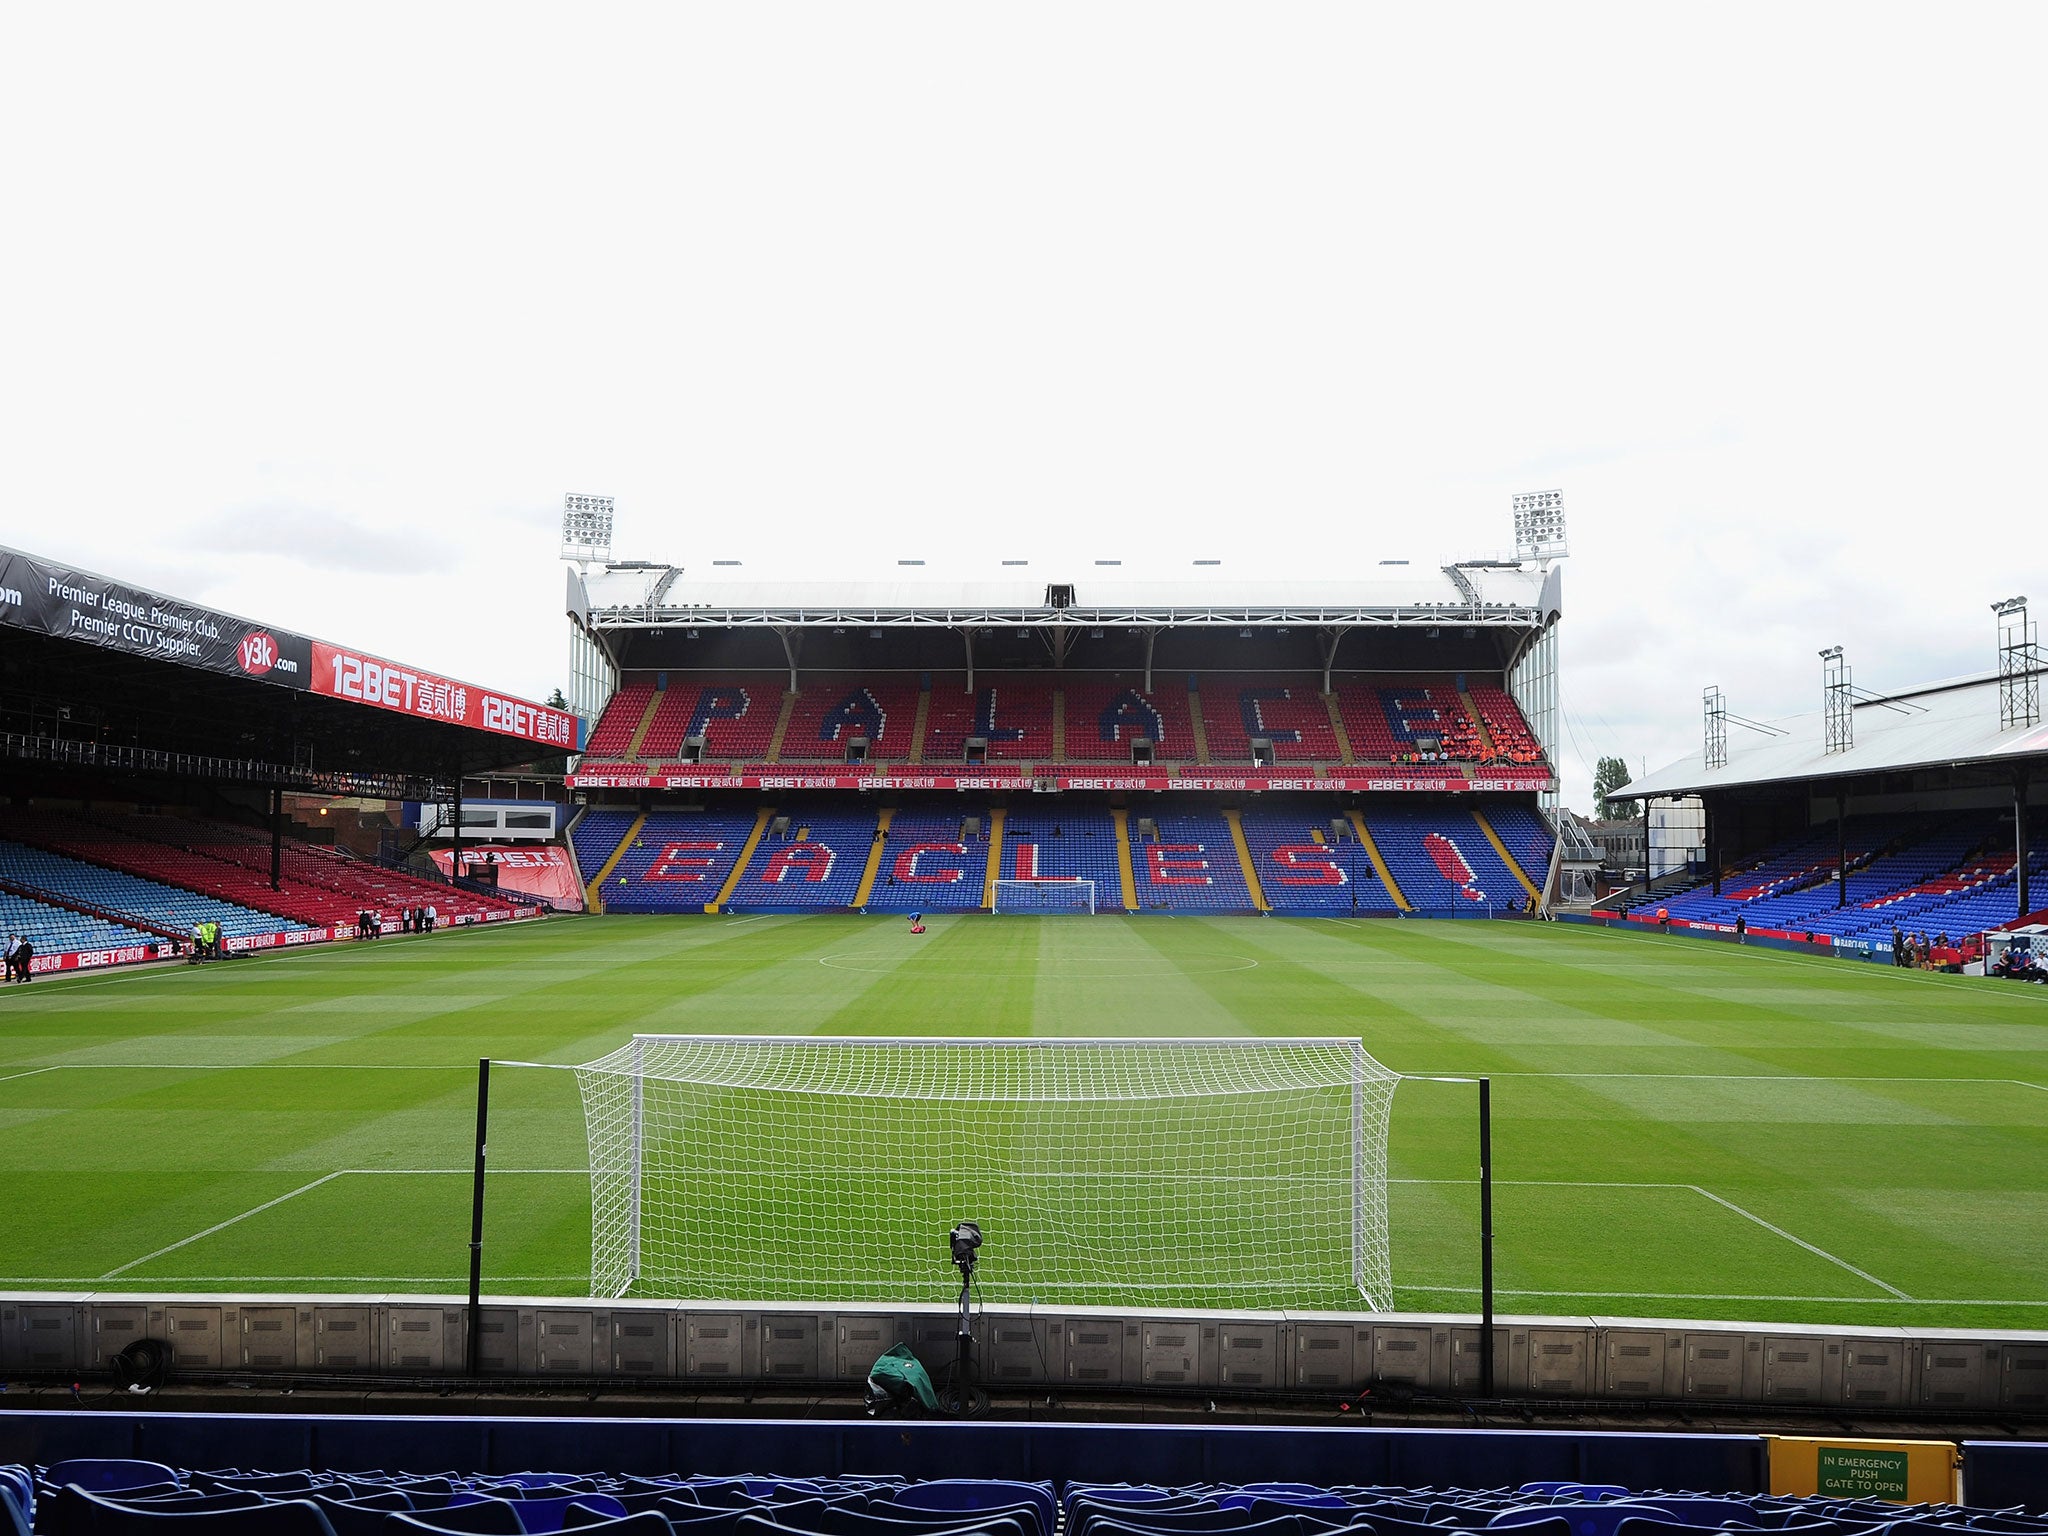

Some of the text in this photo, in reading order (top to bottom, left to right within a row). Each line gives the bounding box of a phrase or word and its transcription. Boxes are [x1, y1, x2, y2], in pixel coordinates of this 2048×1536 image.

[48, 576, 221, 640] Premier League. Premier Club.
[71, 609, 202, 658] Premier CCTV Supplier.
[1824, 1456, 1901, 1470] IN EMERGENCY
[1850, 1469, 1878, 1479] PUSH
[1825, 1478, 1904, 1492] GATE TO OPEN
